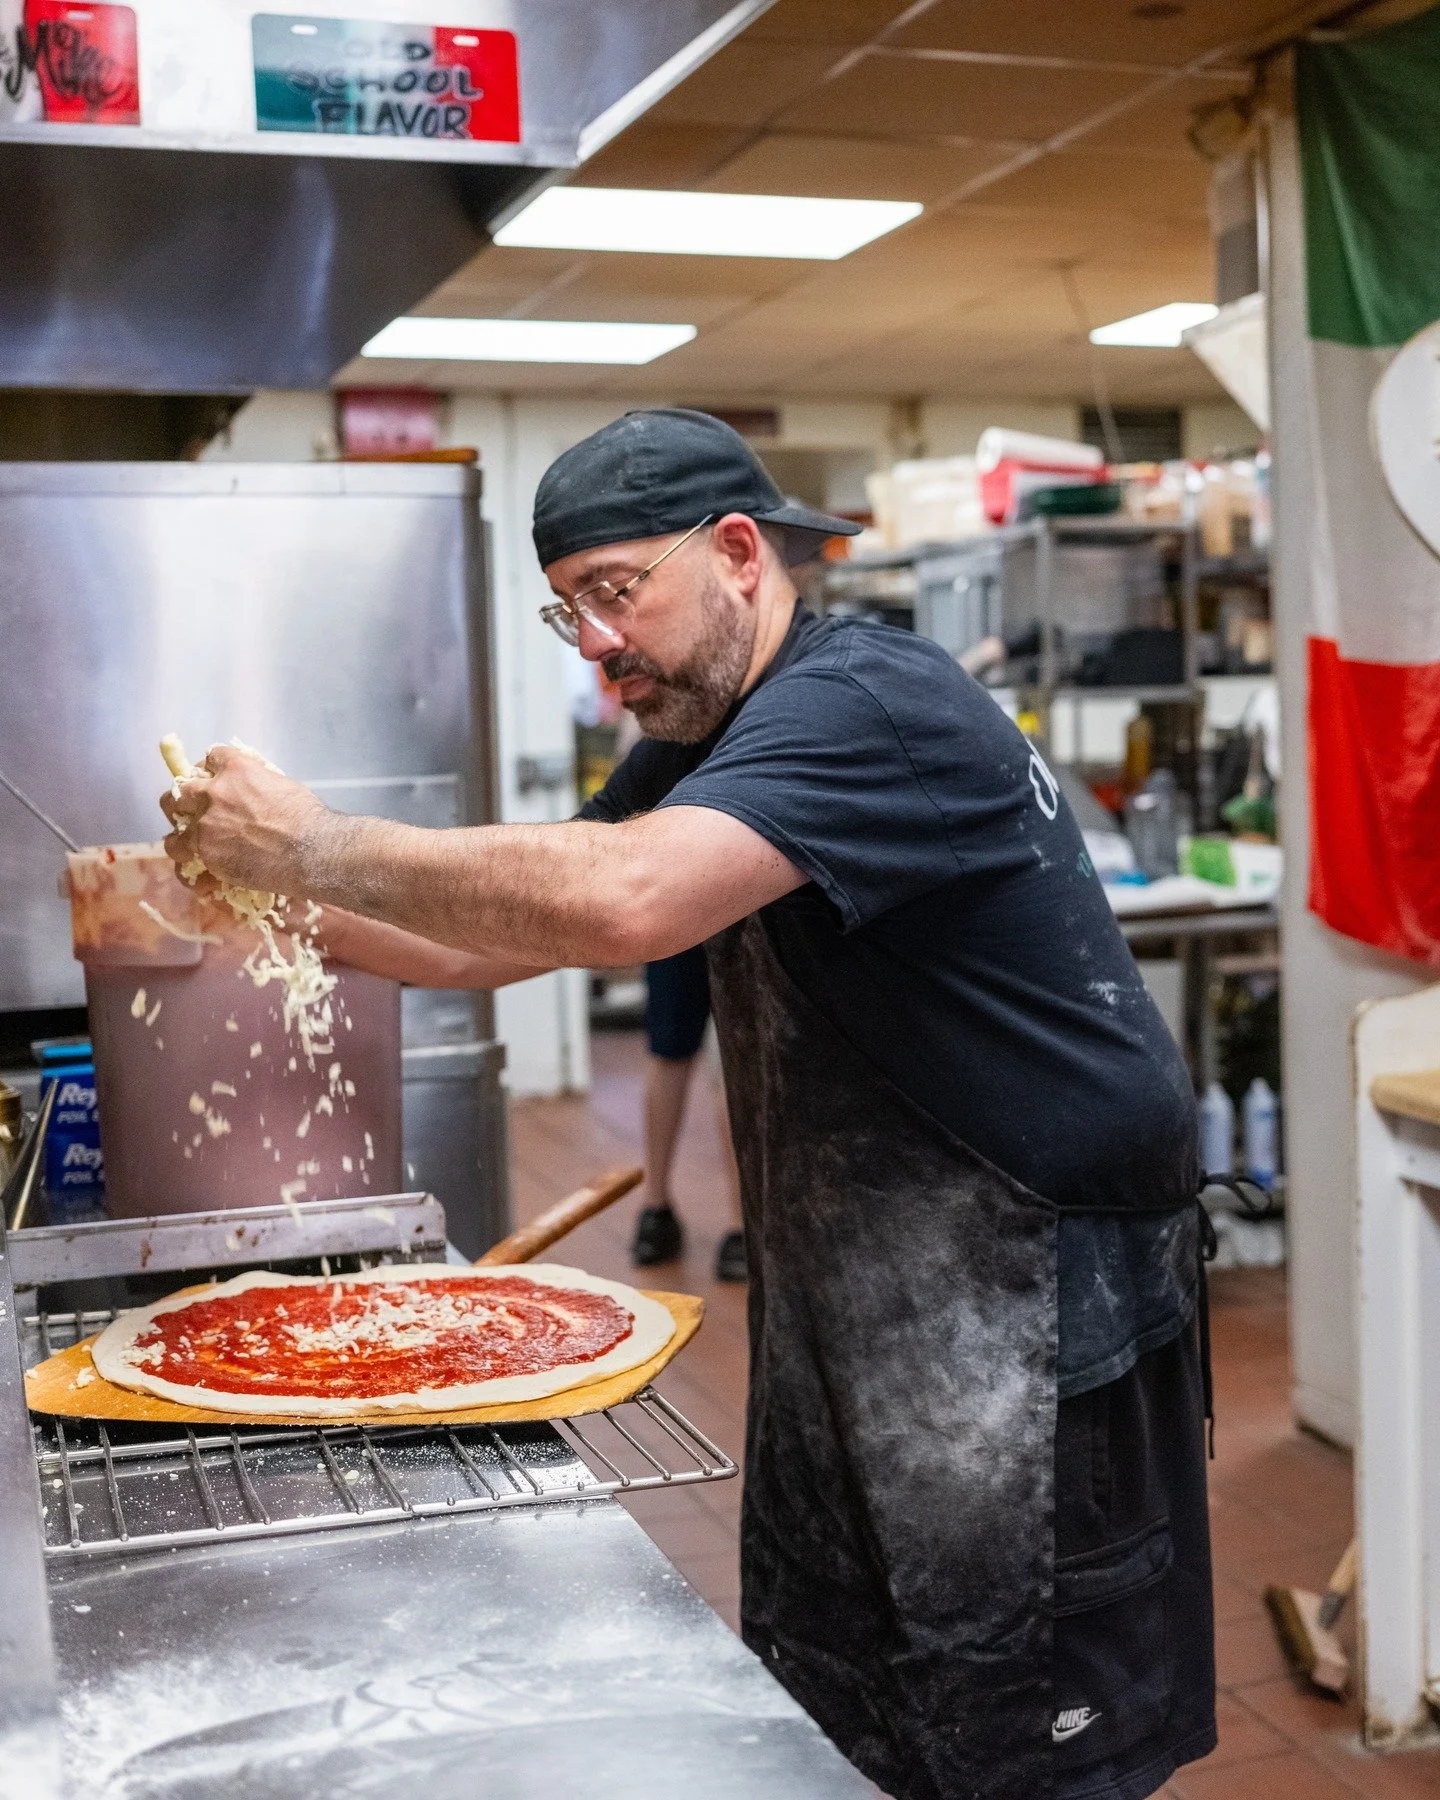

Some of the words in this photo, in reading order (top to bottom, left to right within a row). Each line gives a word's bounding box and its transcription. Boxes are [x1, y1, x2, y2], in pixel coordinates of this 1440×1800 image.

[286, 68, 481, 98] SCHOOL
[314, 102, 472, 141] FLAVOR
[1056, 1707, 1091, 1729] NIKE
